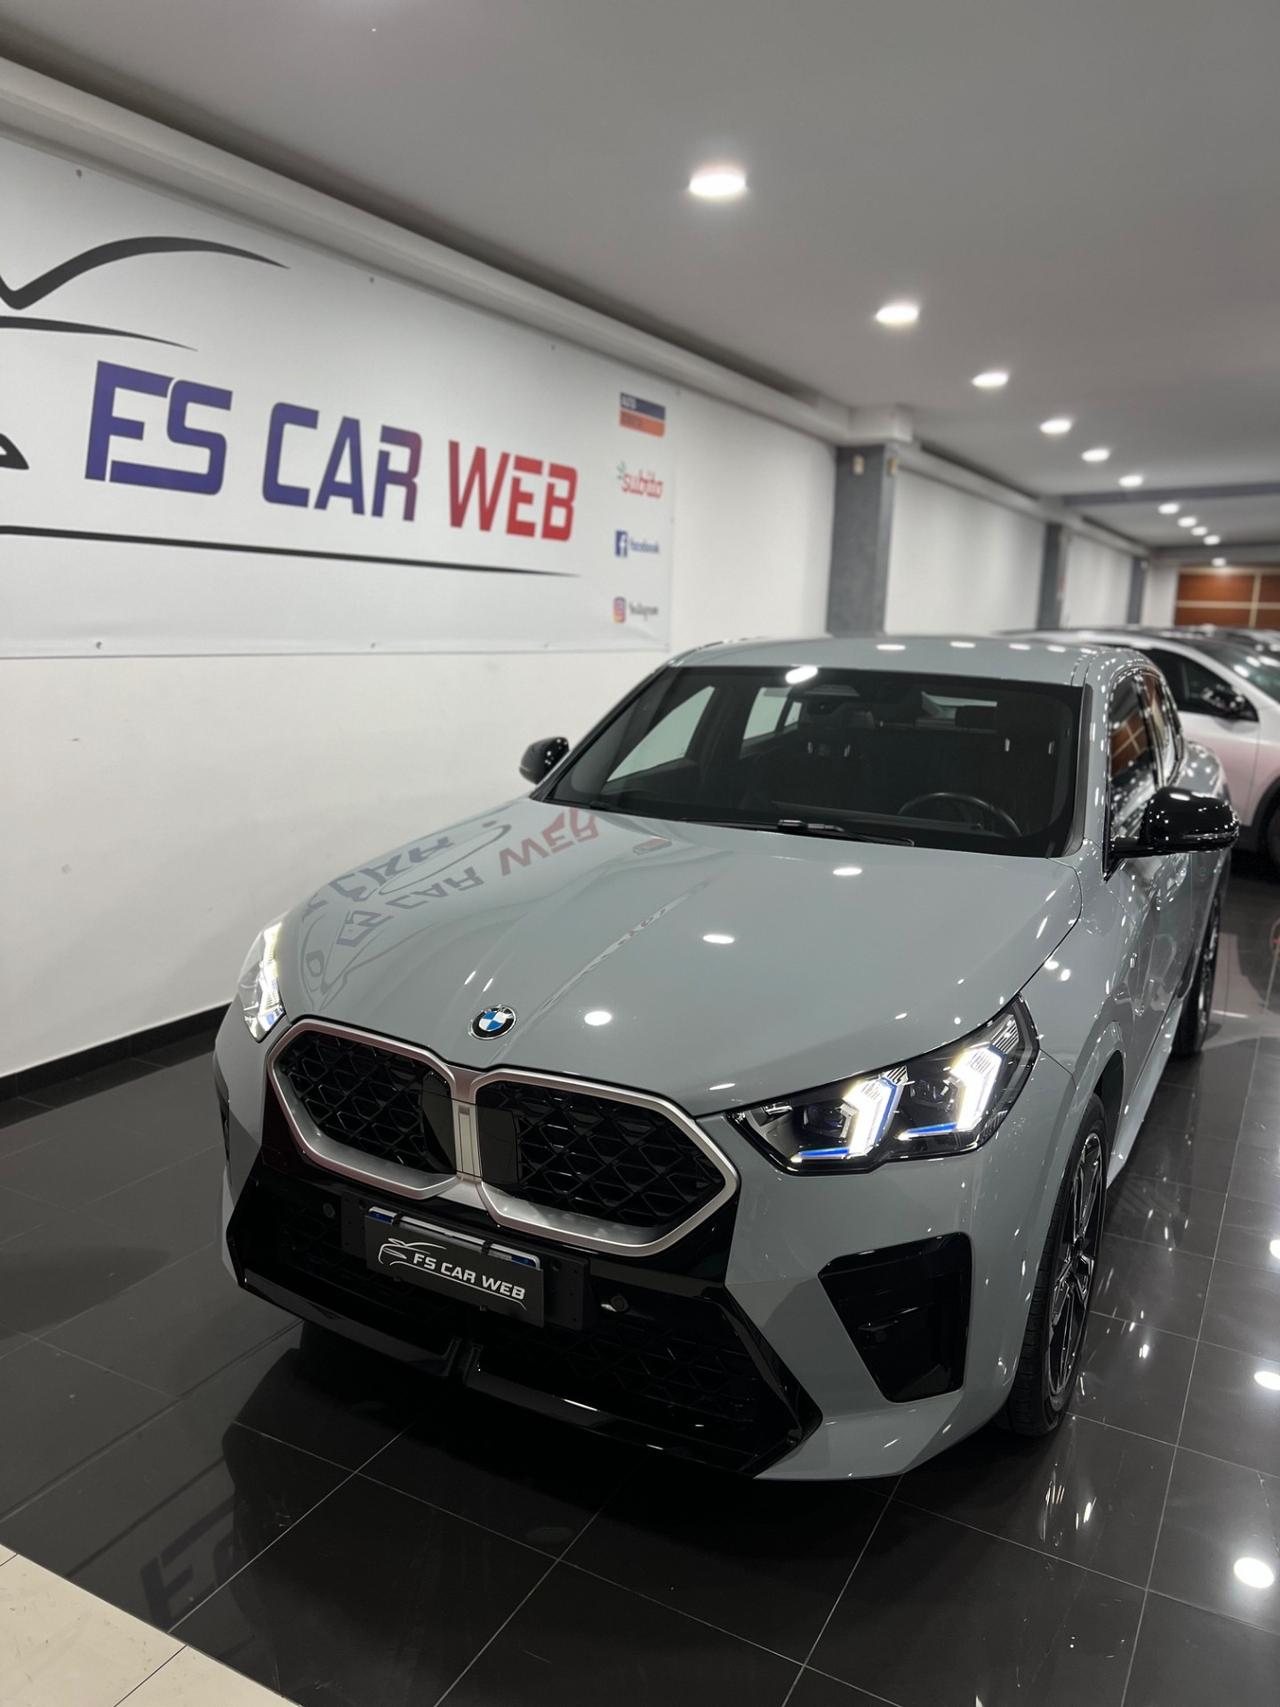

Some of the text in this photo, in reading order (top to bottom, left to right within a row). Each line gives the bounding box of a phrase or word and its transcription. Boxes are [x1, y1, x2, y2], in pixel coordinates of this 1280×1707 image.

[262, 402, 422, 522] CAR
[448, 440, 578, 541] WEB
[413, 1252, 526, 1300] FS CAR WEB
